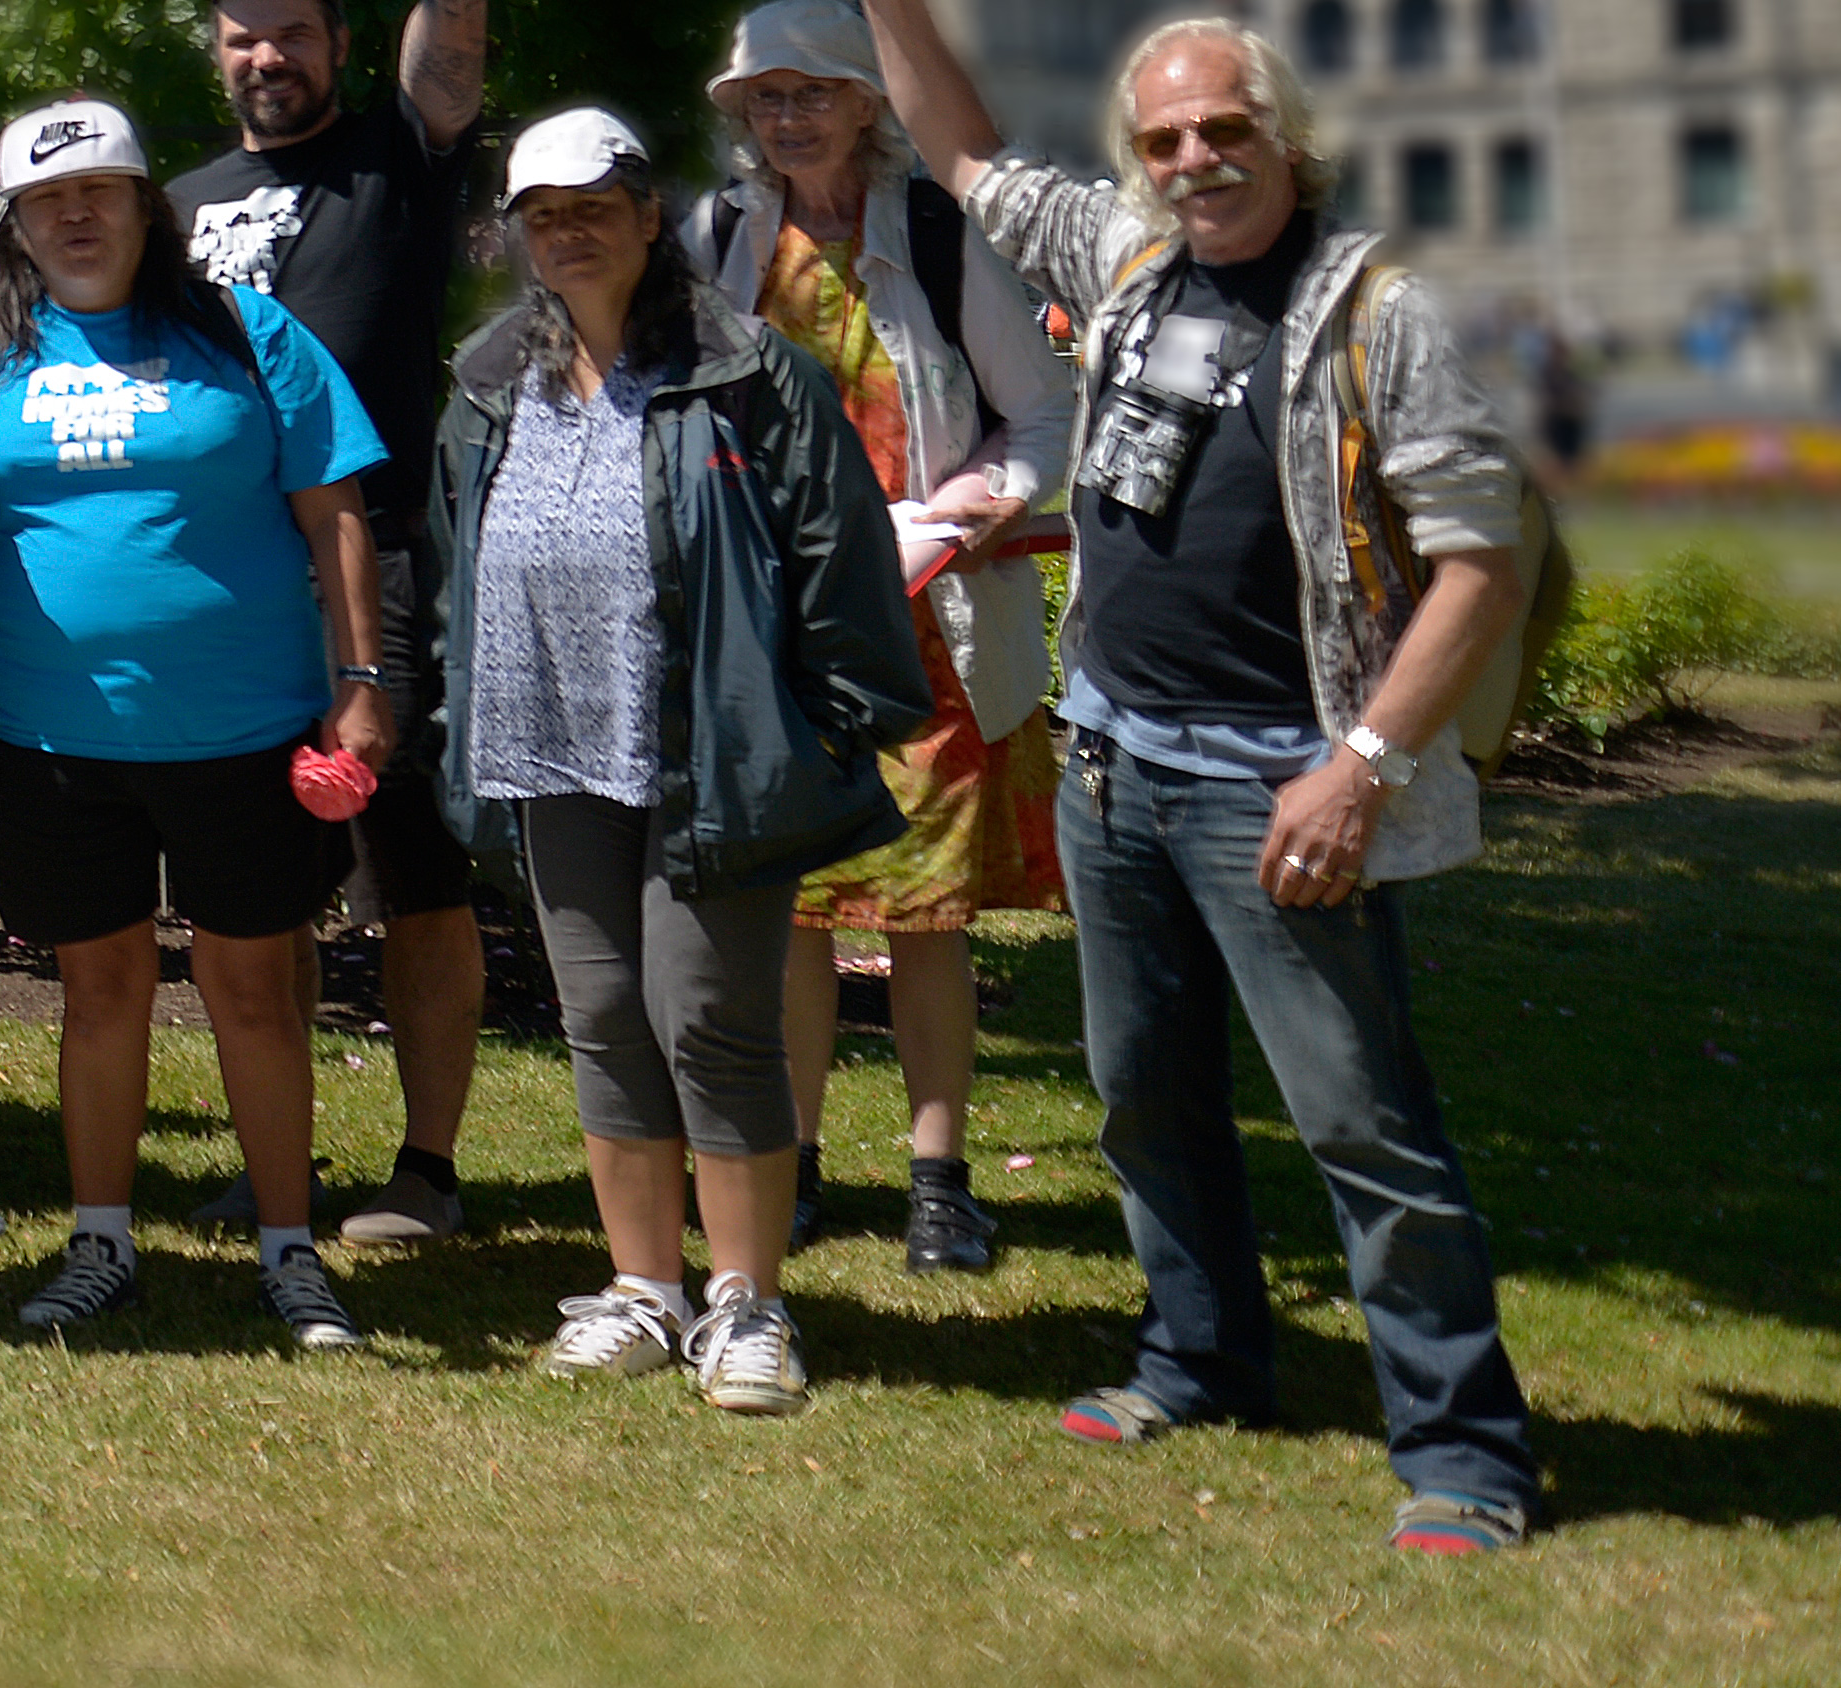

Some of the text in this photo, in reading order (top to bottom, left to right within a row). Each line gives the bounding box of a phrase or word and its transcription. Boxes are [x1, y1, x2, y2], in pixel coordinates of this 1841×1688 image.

[40, 120, 86, 142] NIKE
[22, 384, 170, 424] HOMES
[51, 411, 135, 444] FOR
[57, 438, 134, 472] ALL
